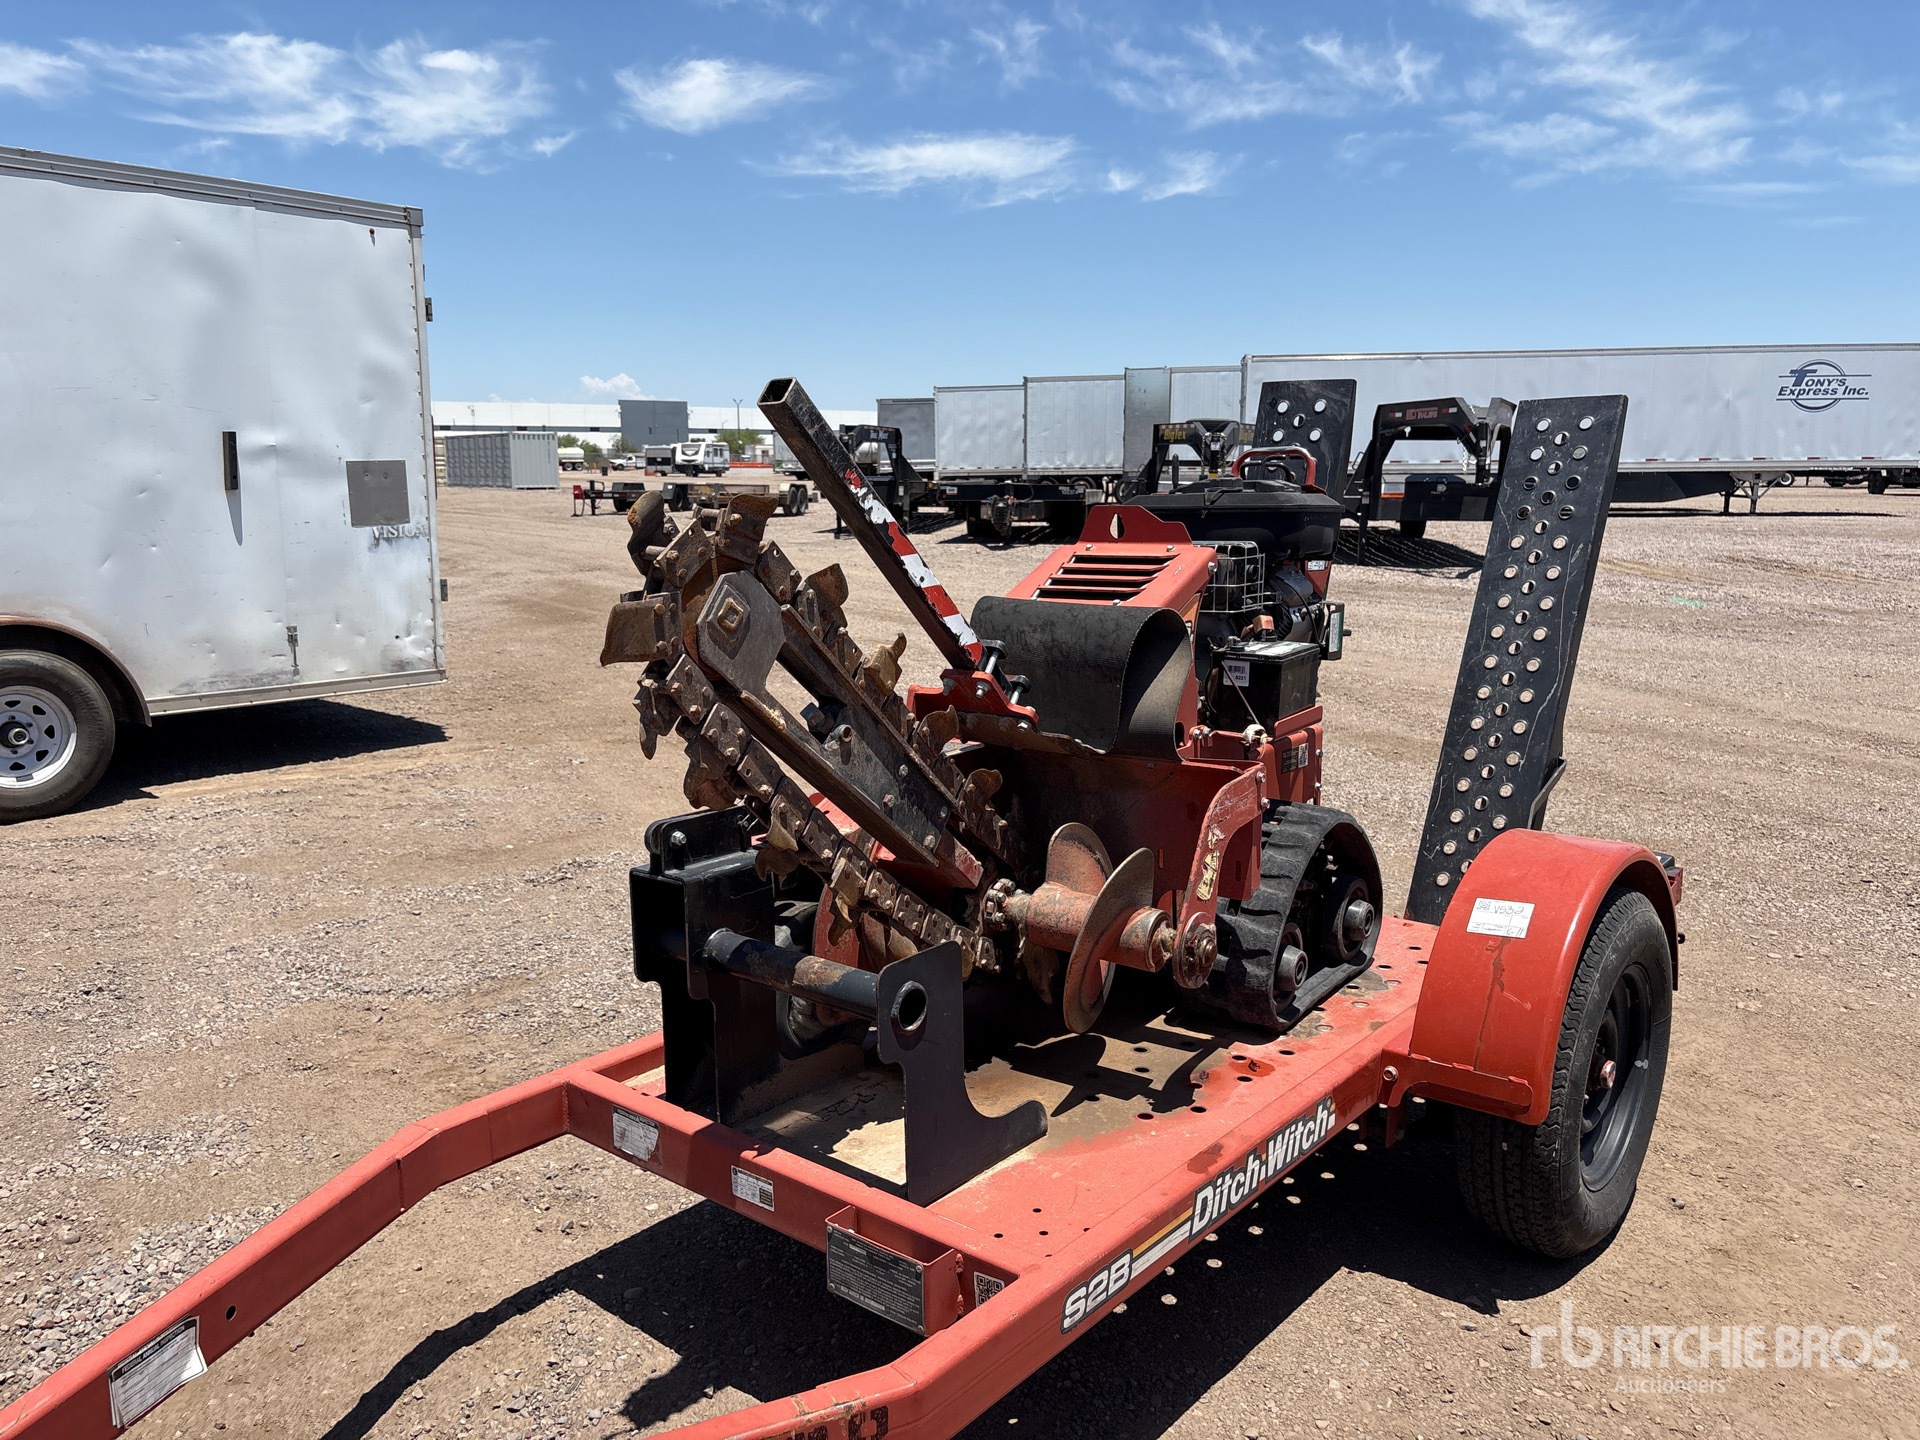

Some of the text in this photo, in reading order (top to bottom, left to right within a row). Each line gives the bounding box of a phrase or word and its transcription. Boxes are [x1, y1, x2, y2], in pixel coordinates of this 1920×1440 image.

[1789, 369, 1847, 387] TONY'S
[1777, 385, 1869, 398] Express Inc.
[1062, 1252, 1132, 1331] S2B
